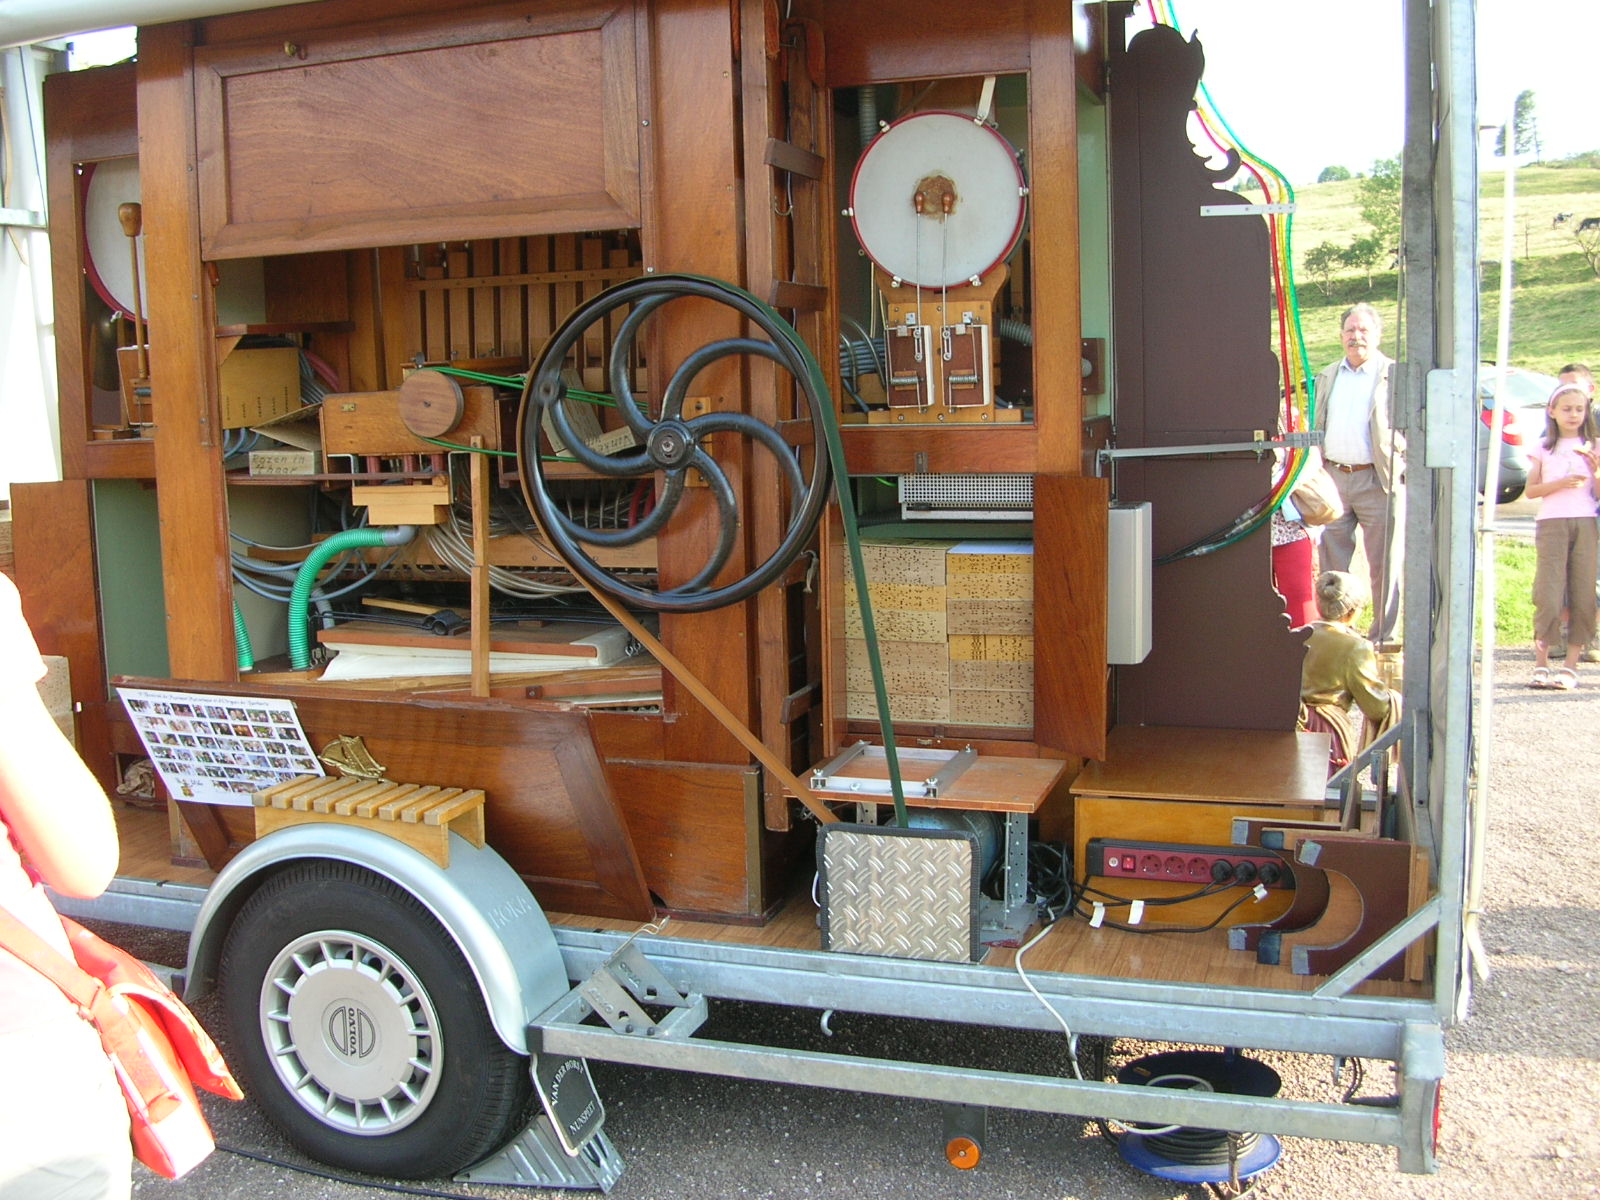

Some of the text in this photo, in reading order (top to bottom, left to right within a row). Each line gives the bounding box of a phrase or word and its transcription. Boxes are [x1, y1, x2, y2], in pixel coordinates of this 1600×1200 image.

[348, 1007, 357, 1056] VOLVO
[551, 1059, 584, 1106] VAN DER HORST
[569, 1100, 595, 1135] NUNSPEET
